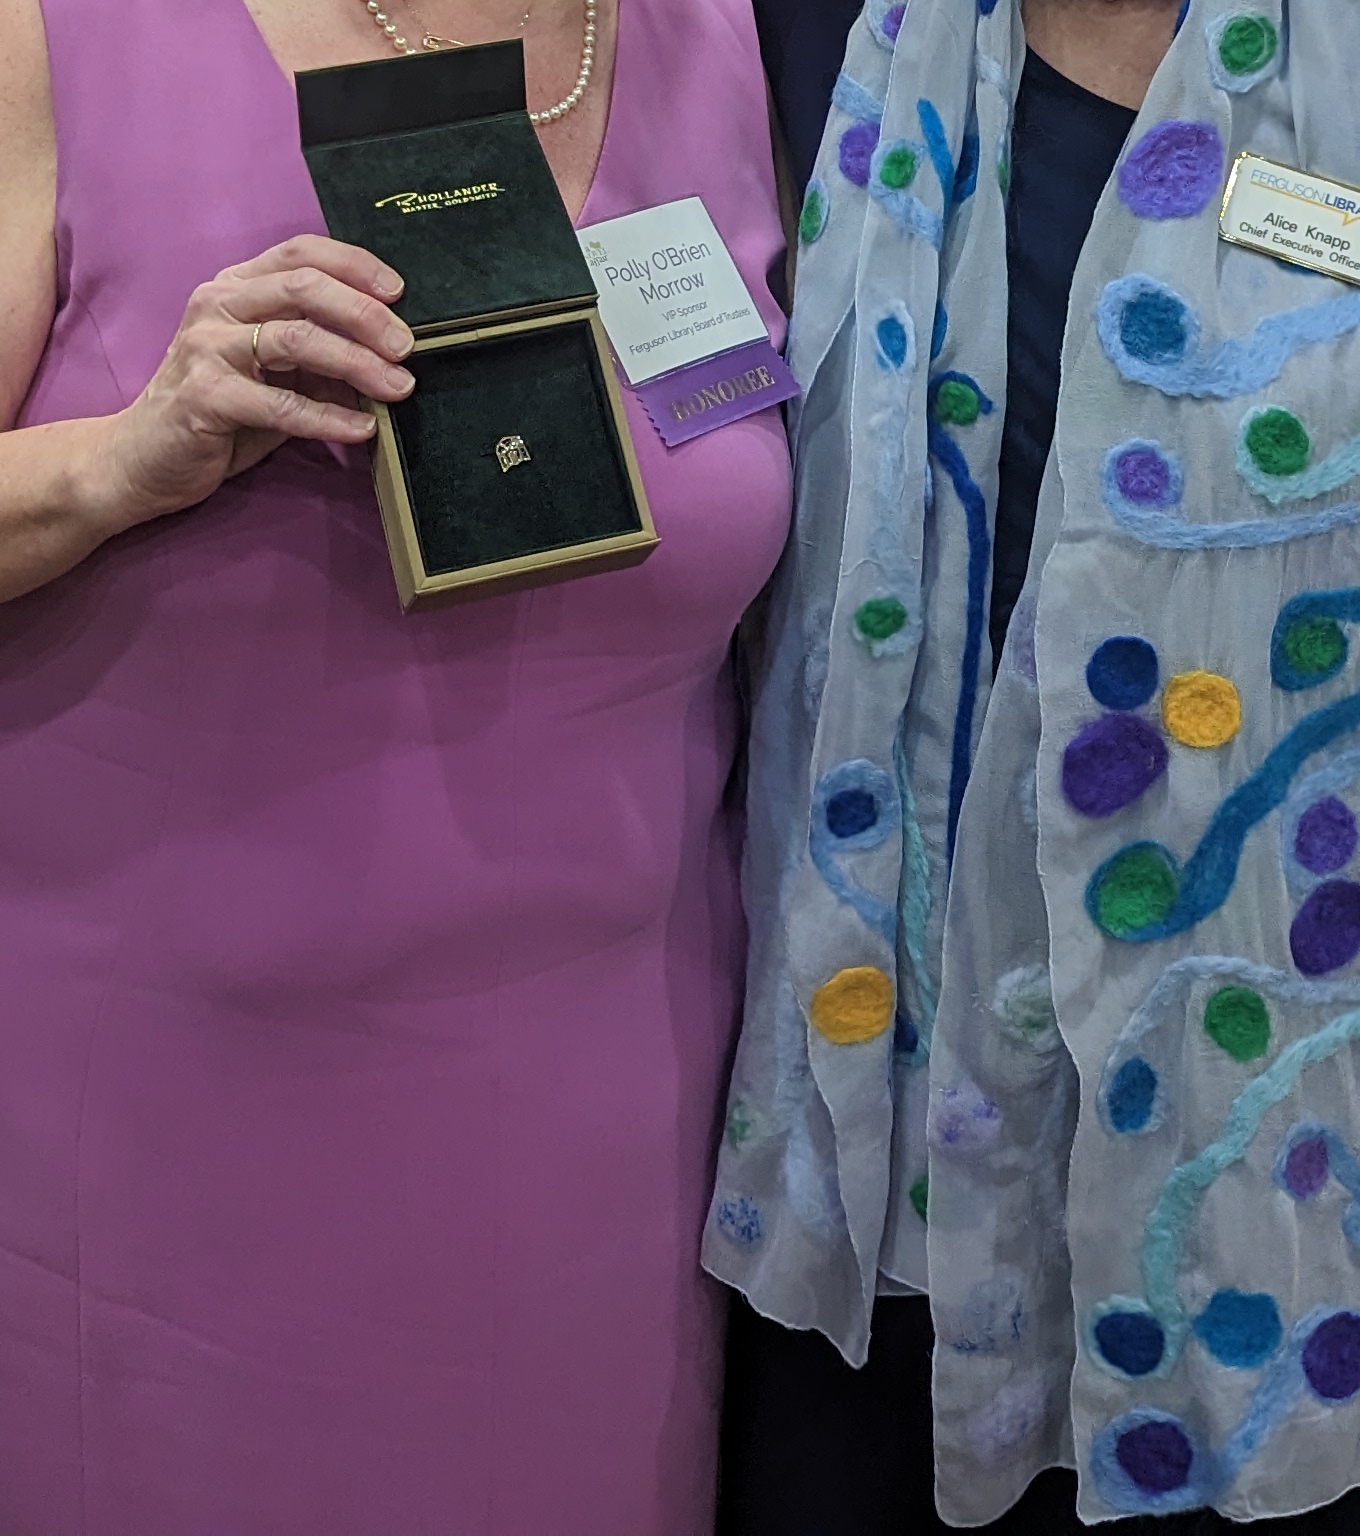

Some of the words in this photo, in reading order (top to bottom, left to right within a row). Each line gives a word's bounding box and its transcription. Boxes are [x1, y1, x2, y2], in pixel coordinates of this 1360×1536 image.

[417, 182, 505, 203] HOLLANDER
[1240, 221, 1268, 240] Chief
[1272, 233, 1323, 258] Executive
[1263, 212, 1298, 233] Alice
[1305, 225, 1351, 251] Knapp
[605, 259, 651, 286] Polly
[652, 242, 711, 271] O'Brien
[639, 272, 705, 304] Morrow
[662, 309, 676, 321] VIP
[677, 301, 708, 317] Sponsor
[629, 335, 668, 355] Ferguson
[667, 325, 694, 341] Library
[693, 317, 716, 332] Board
[670, 365, 776, 422] HONOREE
